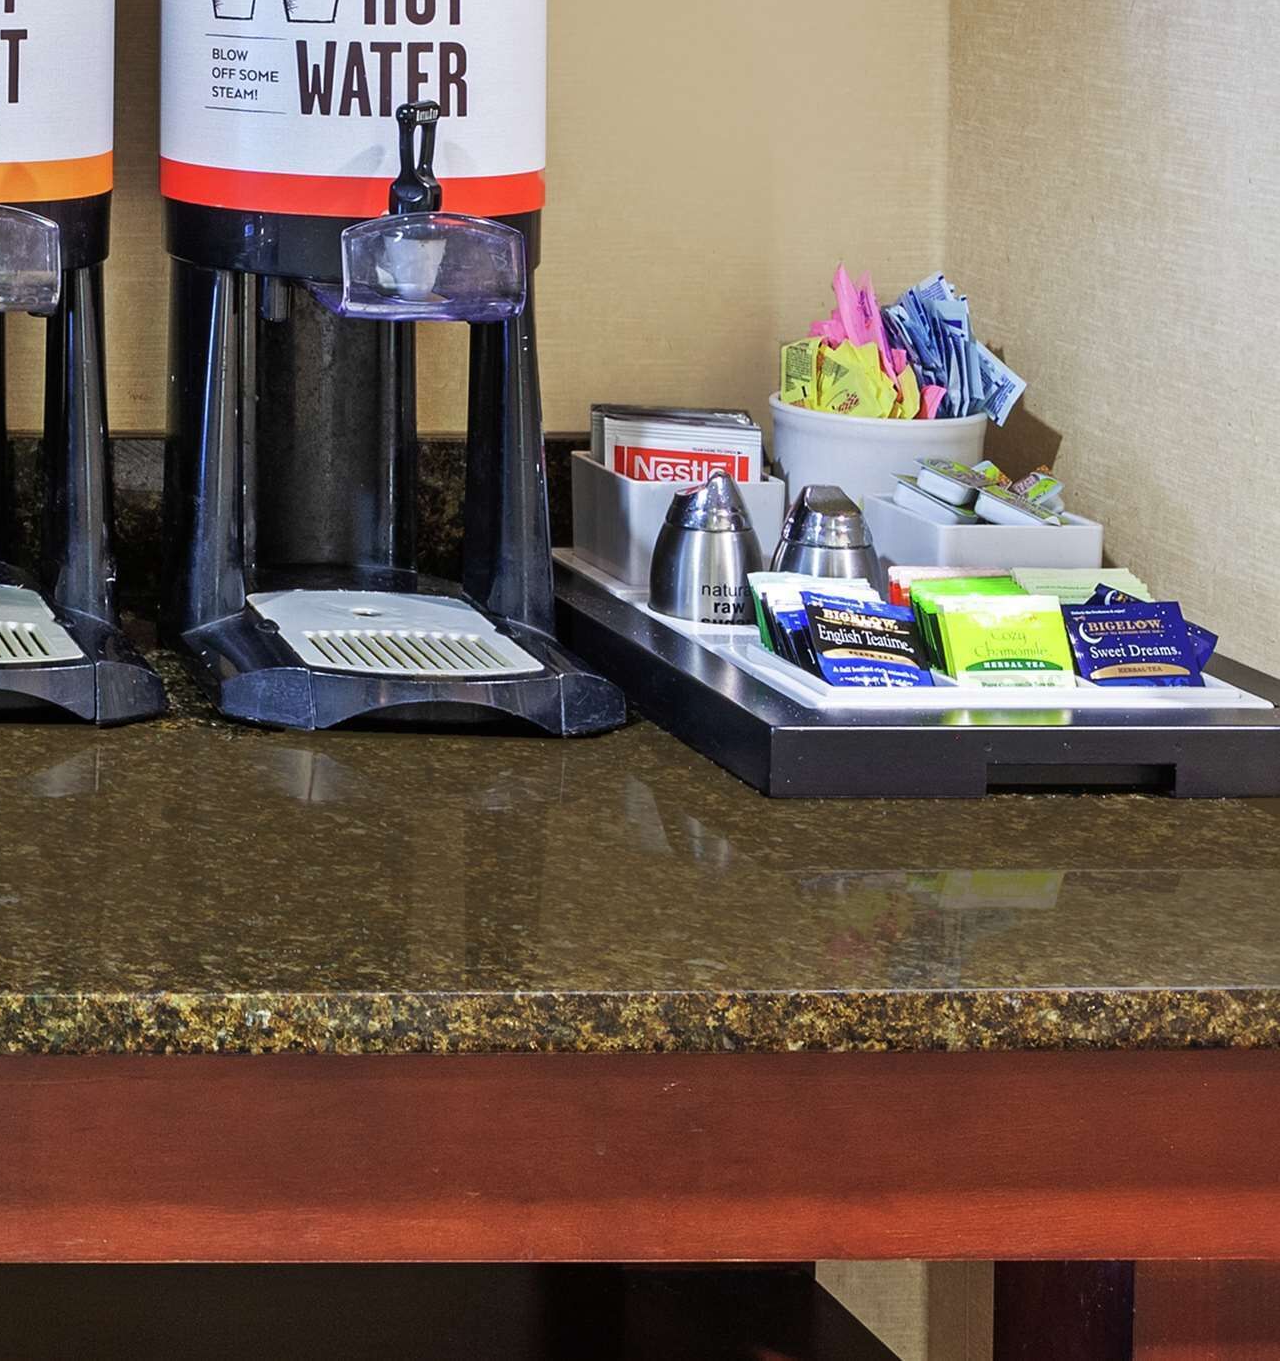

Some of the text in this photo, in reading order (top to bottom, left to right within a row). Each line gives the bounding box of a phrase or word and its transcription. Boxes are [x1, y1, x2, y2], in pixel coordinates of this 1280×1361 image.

[212, 48, 248, 62] BLOW
[212, 67, 279, 83] OFF SOME
[295, 40, 468, 117] WATER
[212, 86, 258, 101] STEAM!
[701, 584, 752, 597] natura
[713, 601, 745, 614] raw
[817, 623, 860, 645] English
[991, 630, 1026, 644] Cozy
[1090, 644, 1125, 659] Sweet
